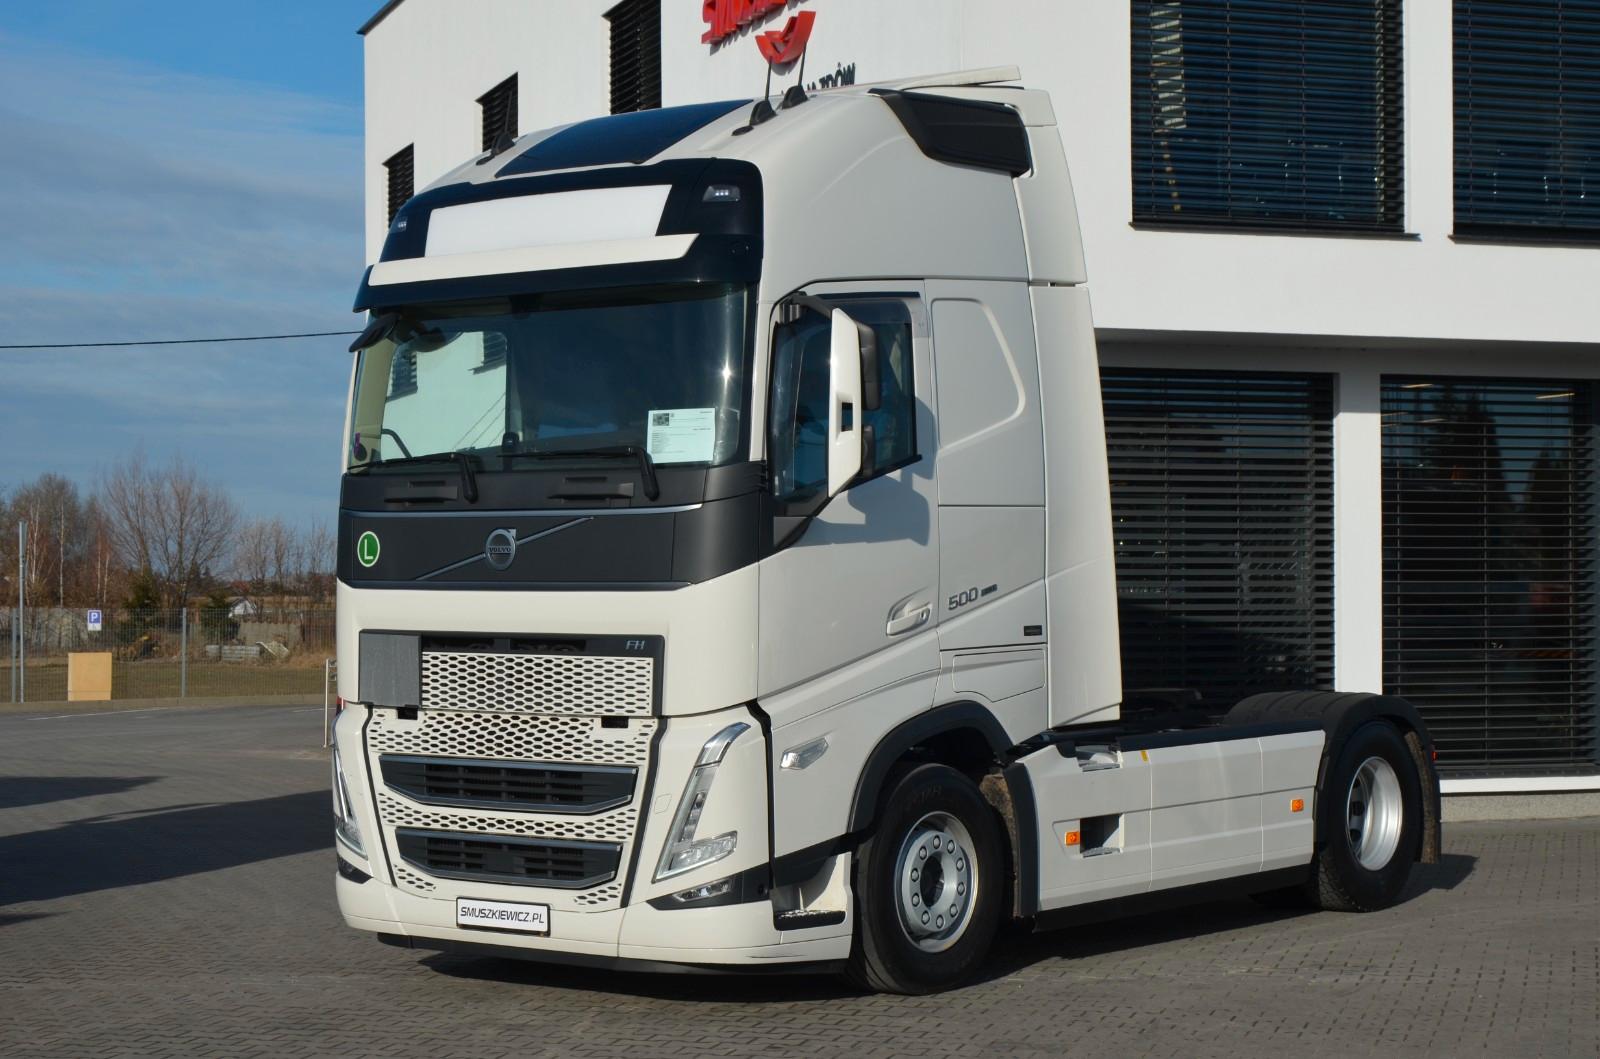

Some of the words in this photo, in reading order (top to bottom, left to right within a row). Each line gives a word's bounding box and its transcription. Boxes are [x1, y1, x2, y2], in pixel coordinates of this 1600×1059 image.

[364, 538, 374, 560] L
[948, 586, 978, 611] 500
[90, 612, 98, 622] P
[625, 640, 646, 650] FH
[460, 906, 545, 924] SMUSZKIEWICZ.PL
